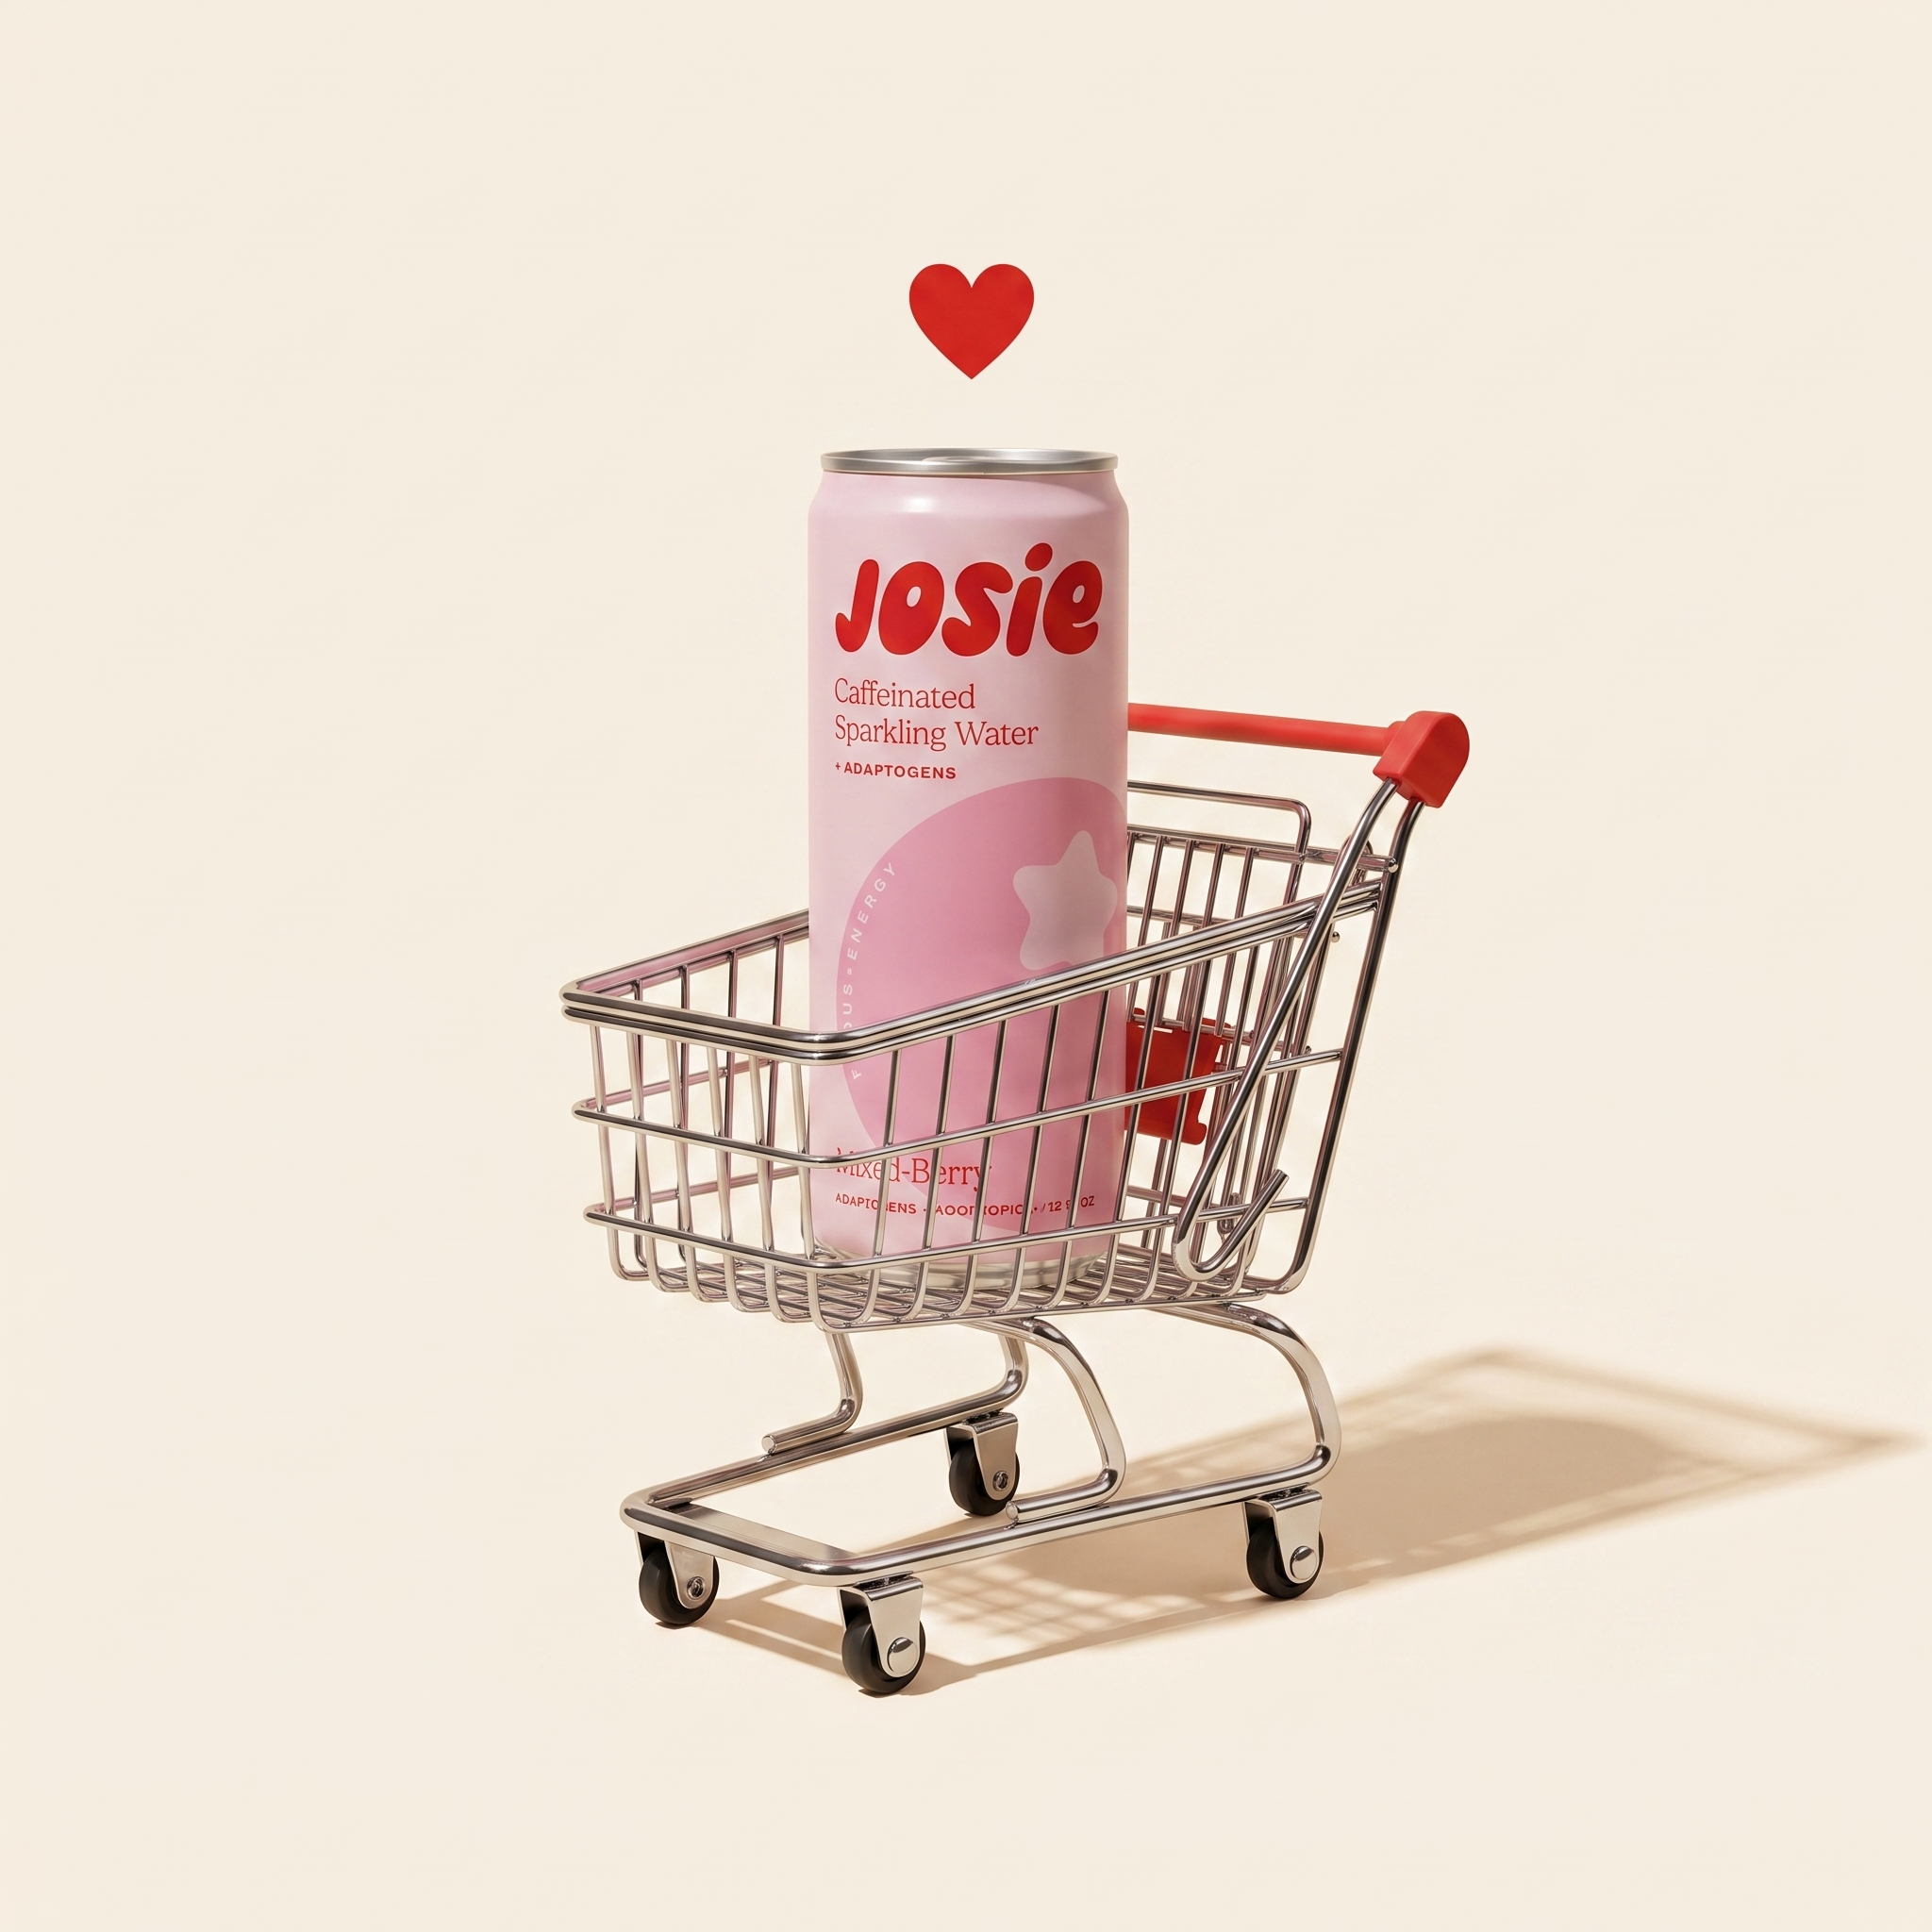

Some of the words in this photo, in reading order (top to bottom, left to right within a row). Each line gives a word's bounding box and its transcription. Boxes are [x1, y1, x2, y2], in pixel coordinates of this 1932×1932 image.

[835, 677, 975, 709] Caffeinated
[835, 714, 947, 752] Sparkling
[955, 721, 1040, 746] Water
[844, 761, 957, 779] ADAPTOGENS
[847, 862, 896, 960] ENERGY
[1047, 1200, 1062, 1212] 12
[1080, 1195, 1095, 1208] OZ
